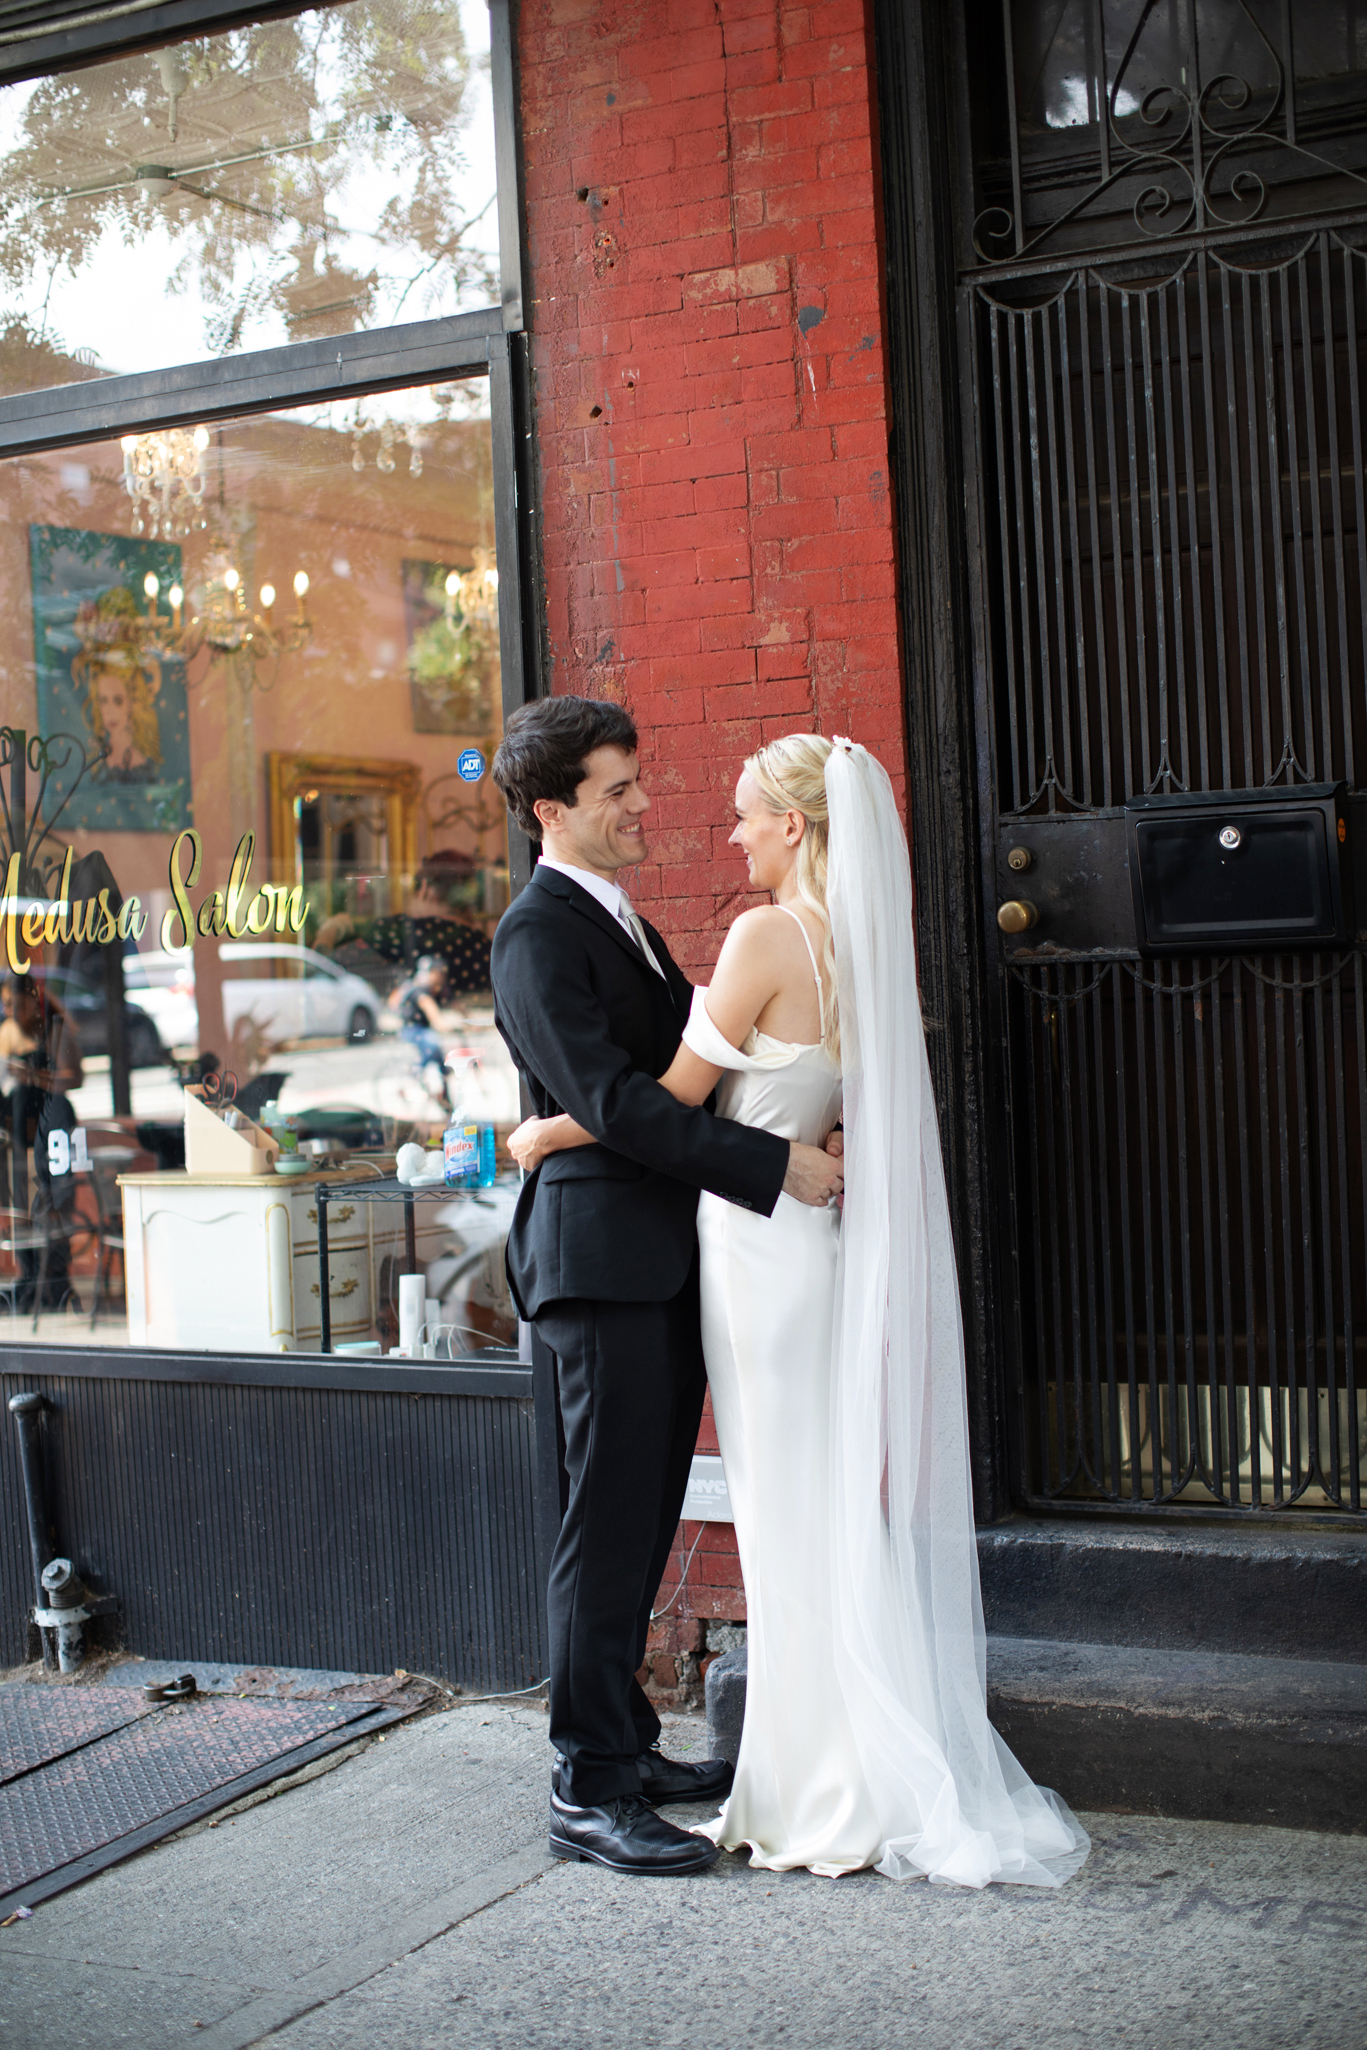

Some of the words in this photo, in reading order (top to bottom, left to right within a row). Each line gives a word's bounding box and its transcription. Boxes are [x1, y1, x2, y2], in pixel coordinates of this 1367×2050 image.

[462, 758, 480, 772] ADT
[161, 828, 310, 957] Salon
[47, 1127, 94, 1176] 91
[688, 1479, 727, 1494] NYC
